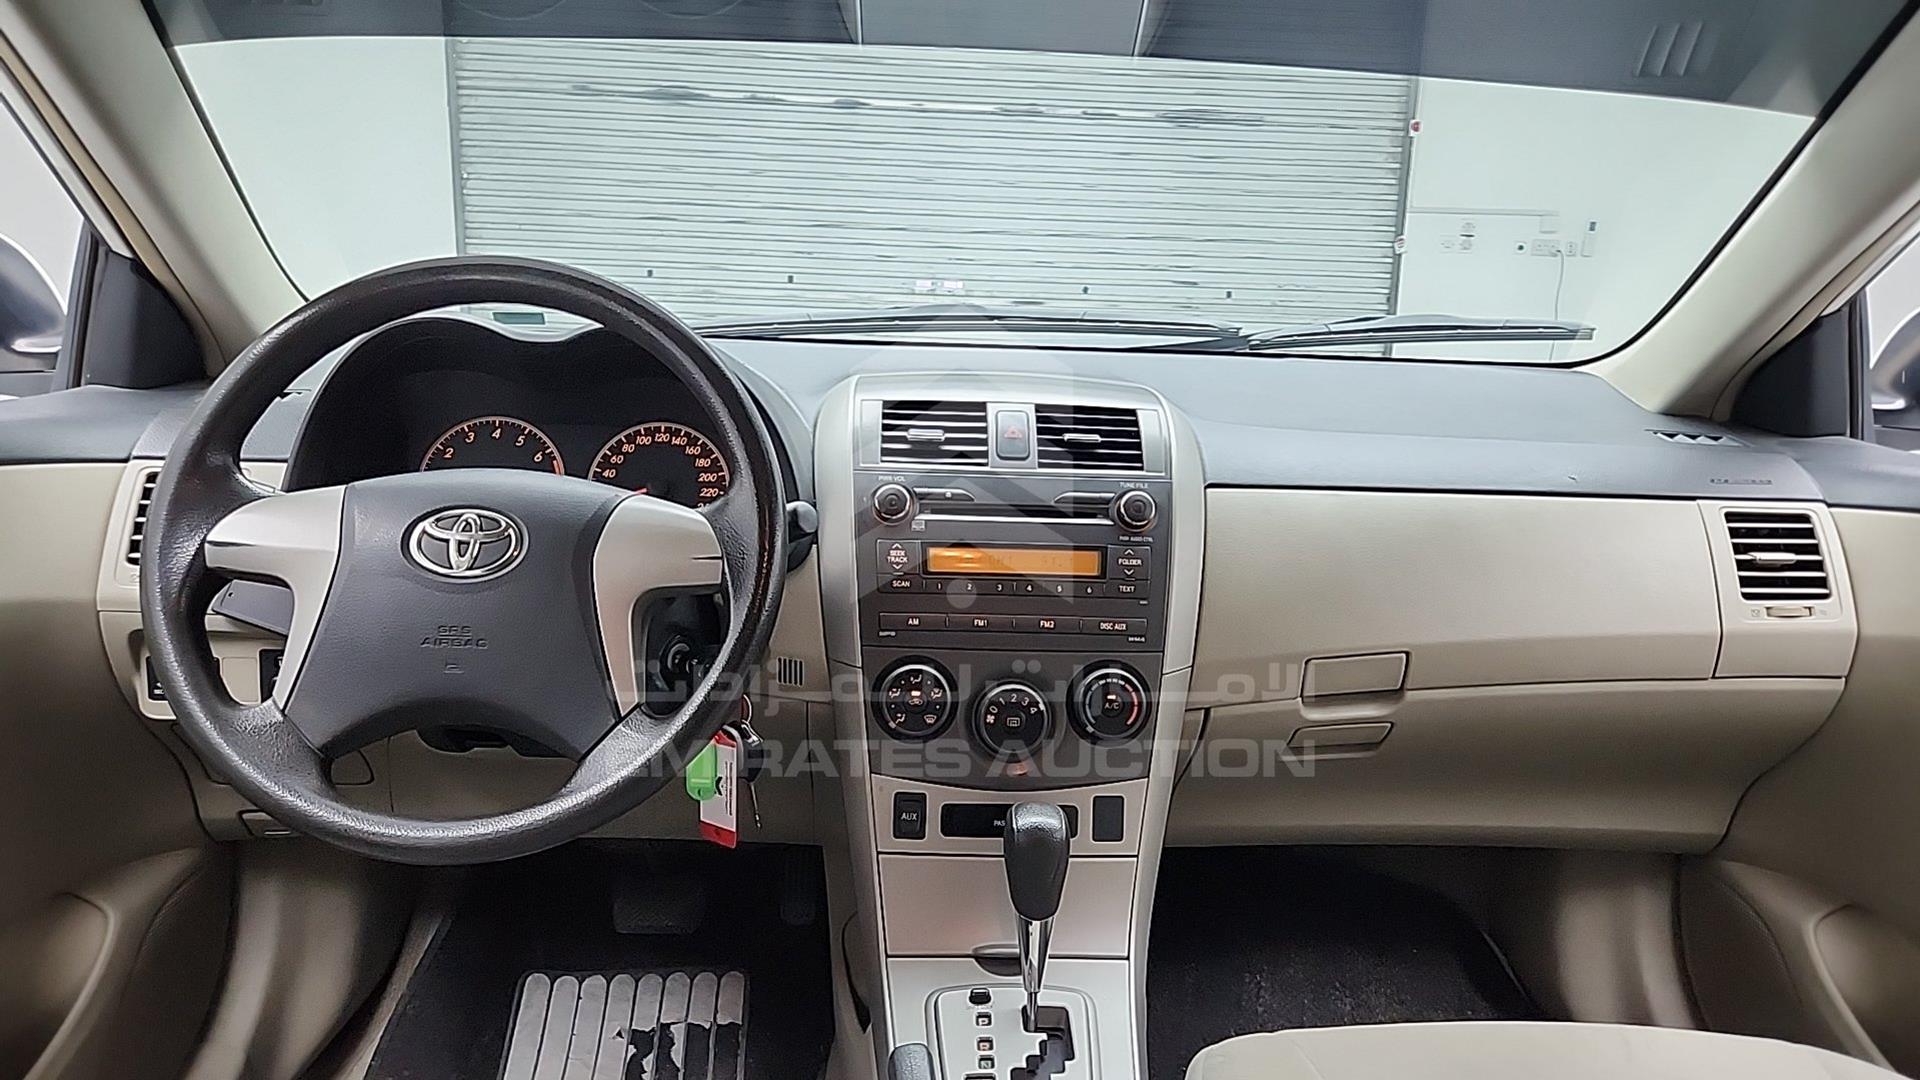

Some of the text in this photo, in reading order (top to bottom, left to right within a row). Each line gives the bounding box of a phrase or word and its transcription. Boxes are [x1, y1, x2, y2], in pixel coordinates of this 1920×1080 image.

[464, 432, 476, 443] 3
[491, 428, 502, 439] 4
[655, 433, 671, 442] 120
[514, 435, 526, 446] 5
[636, 436, 653, 445] 100
[672, 437, 688, 445] 140
[443, 447, 454, 458] 2
[621, 444, 635, 452] 80
[685, 446, 701, 455] 160
[533, 451, 544, 462] 6
[609, 455, 624, 463] 60
[695, 458, 712, 467] 180
[602, 469, 616, 478] 40
[698, 473, 718, 482] 200
[699, 488, 720, 497] 220
[889, 549, 906, 557] SEEK
[1118, 558, 1142, 566] FOLDER
[892, 580, 911, 588] SCAN
[1118, 585, 1135, 593] TEXT
[907, 617, 920, 626] AM
[973, 619, 988, 627] FM1
[1039, 620, 1055, 629] FM2
[420, 637, 488, 649] AIRBAG
[999, 696, 1006, 706] 1
[1010, 693, 1018, 702] 2
[1021, 696, 1030, 706] 3
[989, 705, 998, 713] 0
[1104, 701, 1120, 710] A/C
[900, 812, 918, 821] AUX
[978, 1017, 989, 1026] P
